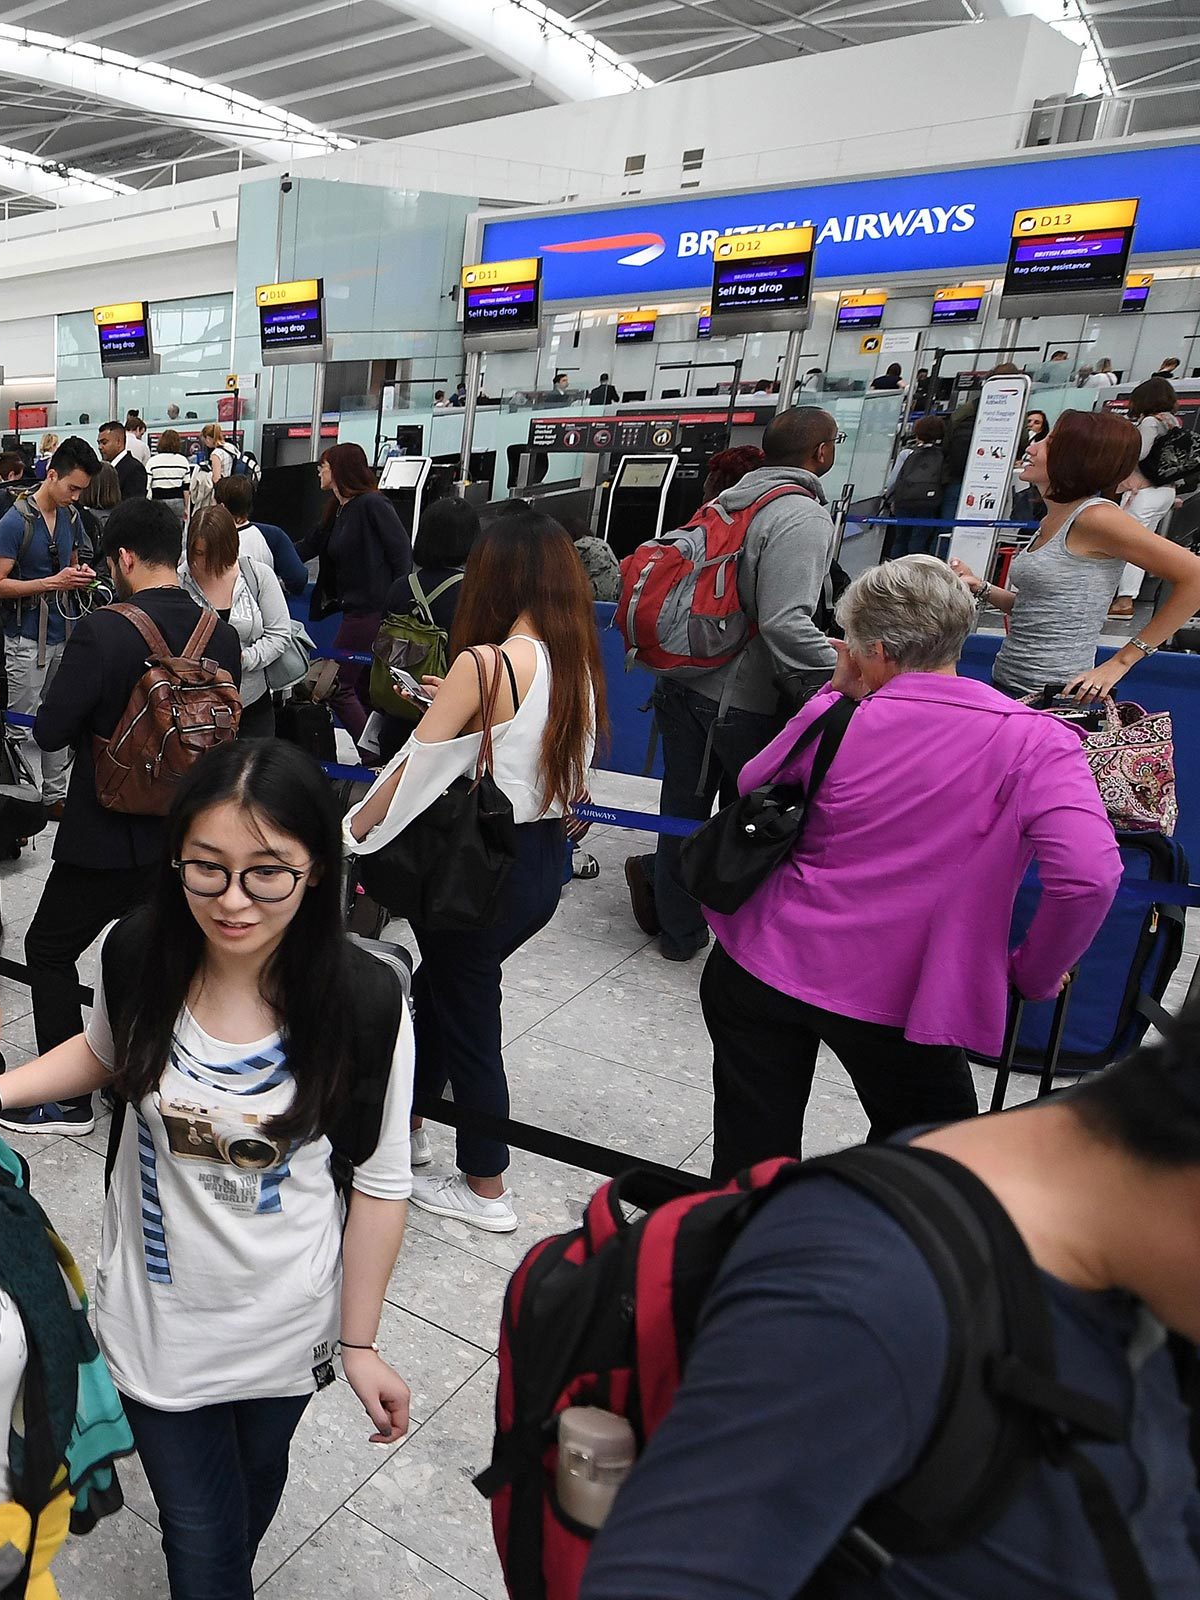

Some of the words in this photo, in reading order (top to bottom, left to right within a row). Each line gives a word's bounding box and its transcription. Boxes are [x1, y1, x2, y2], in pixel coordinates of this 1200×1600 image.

[815, 203, 976, 245] AIRWAYS
[1040, 214, 1072, 227] D13
[735, 240, 761, 252] D12
[1013, 266, 1029, 275] Bag
[1030, 264, 1050, 273] drop
[1051, 262, 1092, 271] assistance
[478, 270, 498, 280] D11
[269, 290, 286, 299] D10
[717, 285, 736, 296] Self
[738, 285, 757, 296] bag
[758, 283, 783, 293] drop
[468, 309, 482, 318] Self
[483, 308, 498, 318] bag
[499, 307, 518, 316] drop
[264, 326, 276, 335] Self
[276, 325, 289, 334] bag
[289, 324, 305, 333] drop
[580, 809, 617, 821] AIRWAYS
[198, 1172, 220, 1182] HOW
[223, 1178, 237, 1189] DO
[239, 1173, 258, 1188] YOU
[204, 1182, 237, 1195] WATCH
